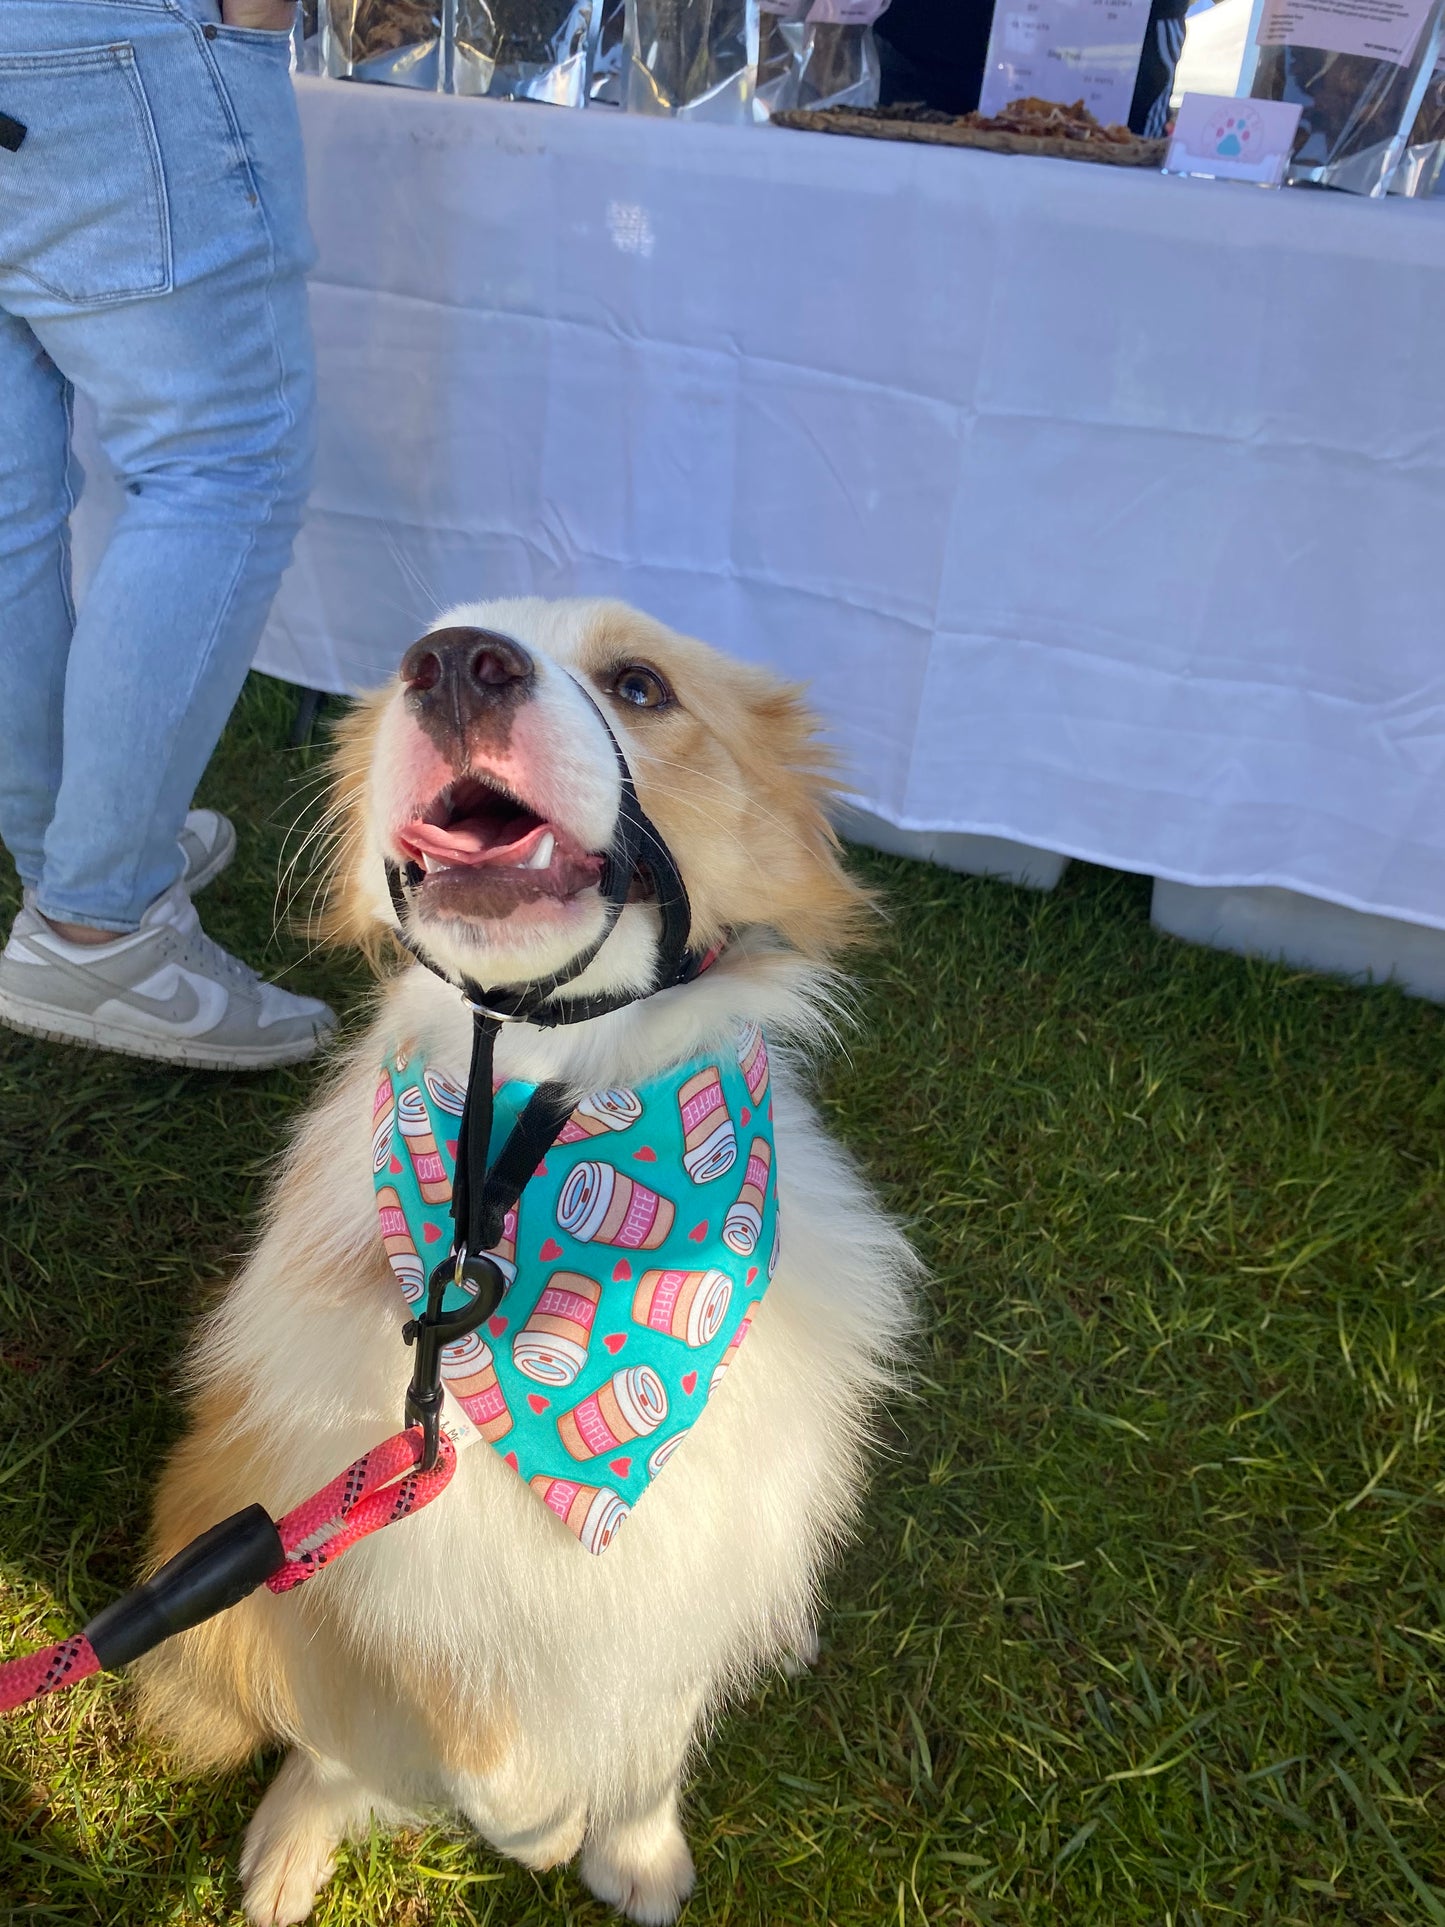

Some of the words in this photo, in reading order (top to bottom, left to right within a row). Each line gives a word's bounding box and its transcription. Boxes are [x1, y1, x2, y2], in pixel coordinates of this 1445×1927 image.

[683, 1085, 721, 1126] COFFEE
[620, 1191, 656, 1246] COFFEE
[544, 1291, 593, 1322] COFFEE
[651, 1273, 681, 1328] COFFEE
[576, 1402, 613, 1453] COFFEE
